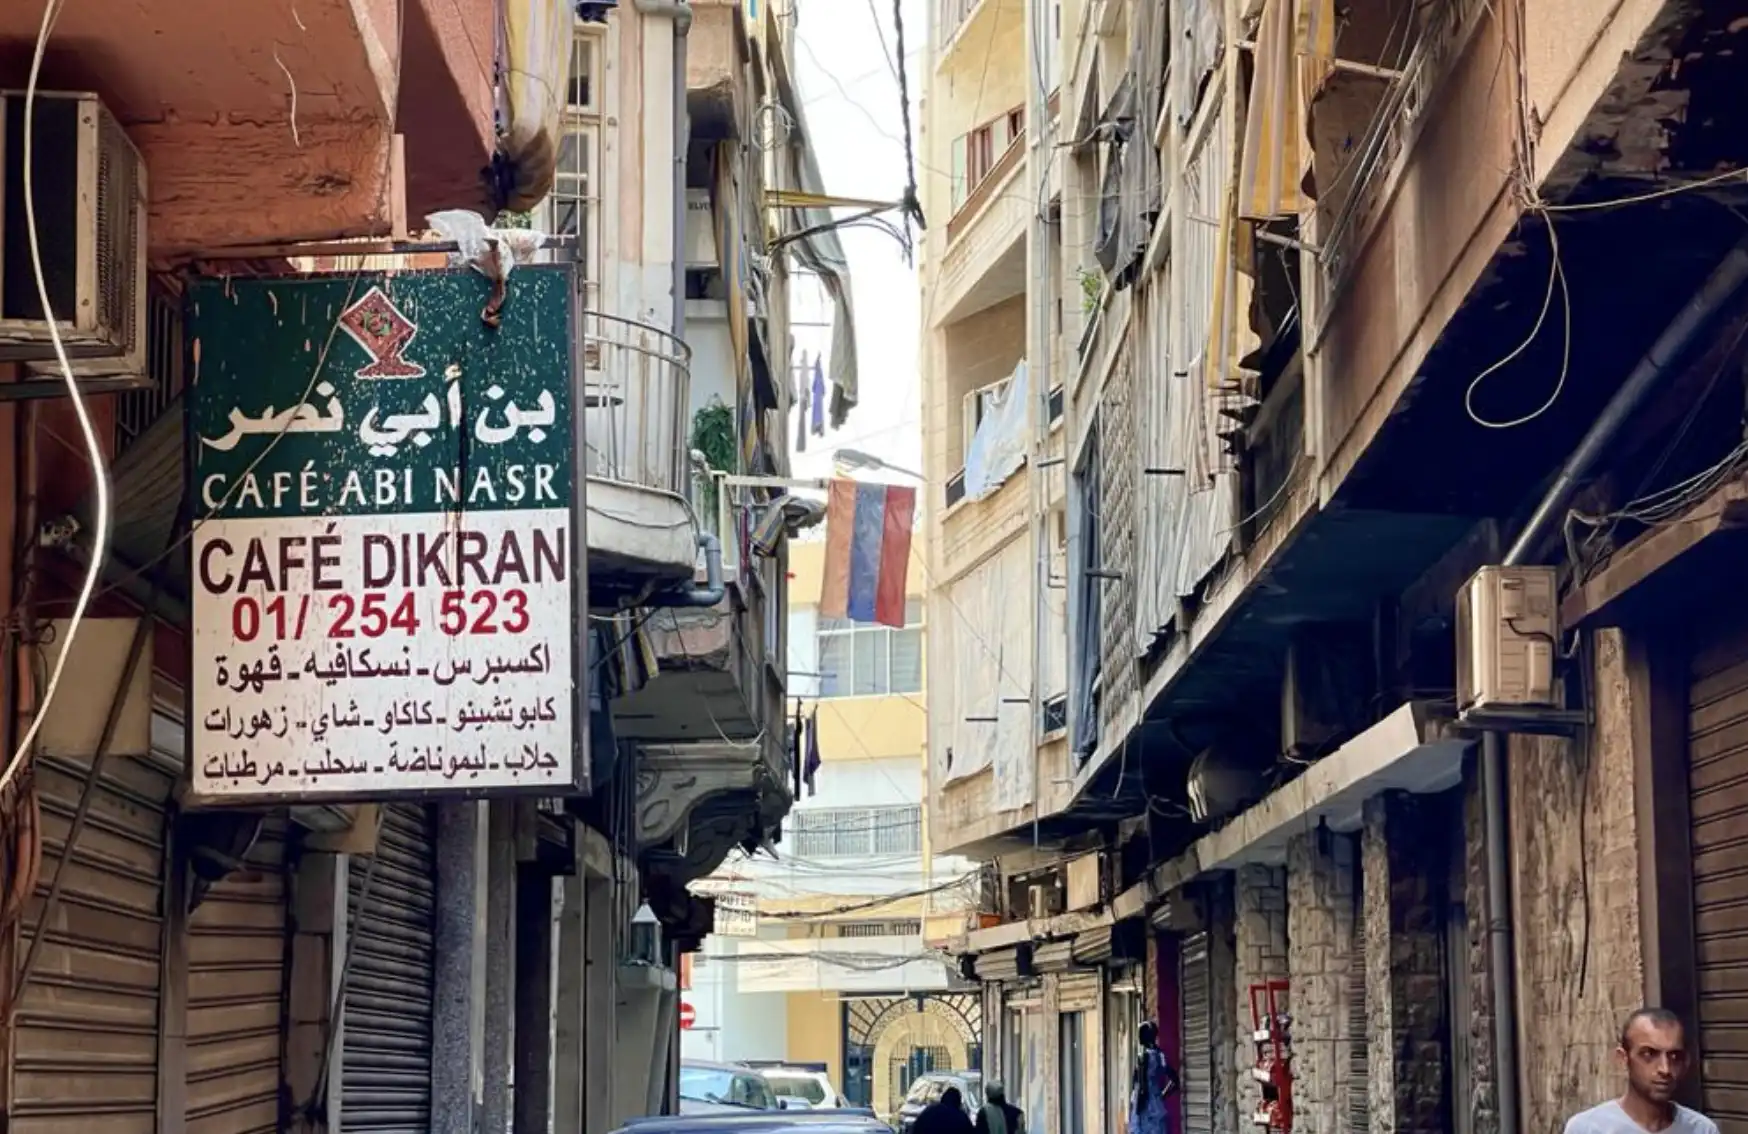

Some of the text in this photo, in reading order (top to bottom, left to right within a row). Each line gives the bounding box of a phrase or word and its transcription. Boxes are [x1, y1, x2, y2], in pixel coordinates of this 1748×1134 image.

[202, 364, 555, 457] بن أبي نصر
[202, 460, 559, 509] CAFÉ ABI NASR
[199, 521, 566, 595] CAFÉ DIKRAN
[232, 588, 530, 642] 01/ 254 523
[215, 644, 282, 693] قهوة
[204, 705, 288, 739] زهورات
[311, 700, 361, 742] شاي
[378, 700, 433, 734] كاكاو
[203, 741, 559, 785] جلاب ليموناضة سحلب مرطبات
